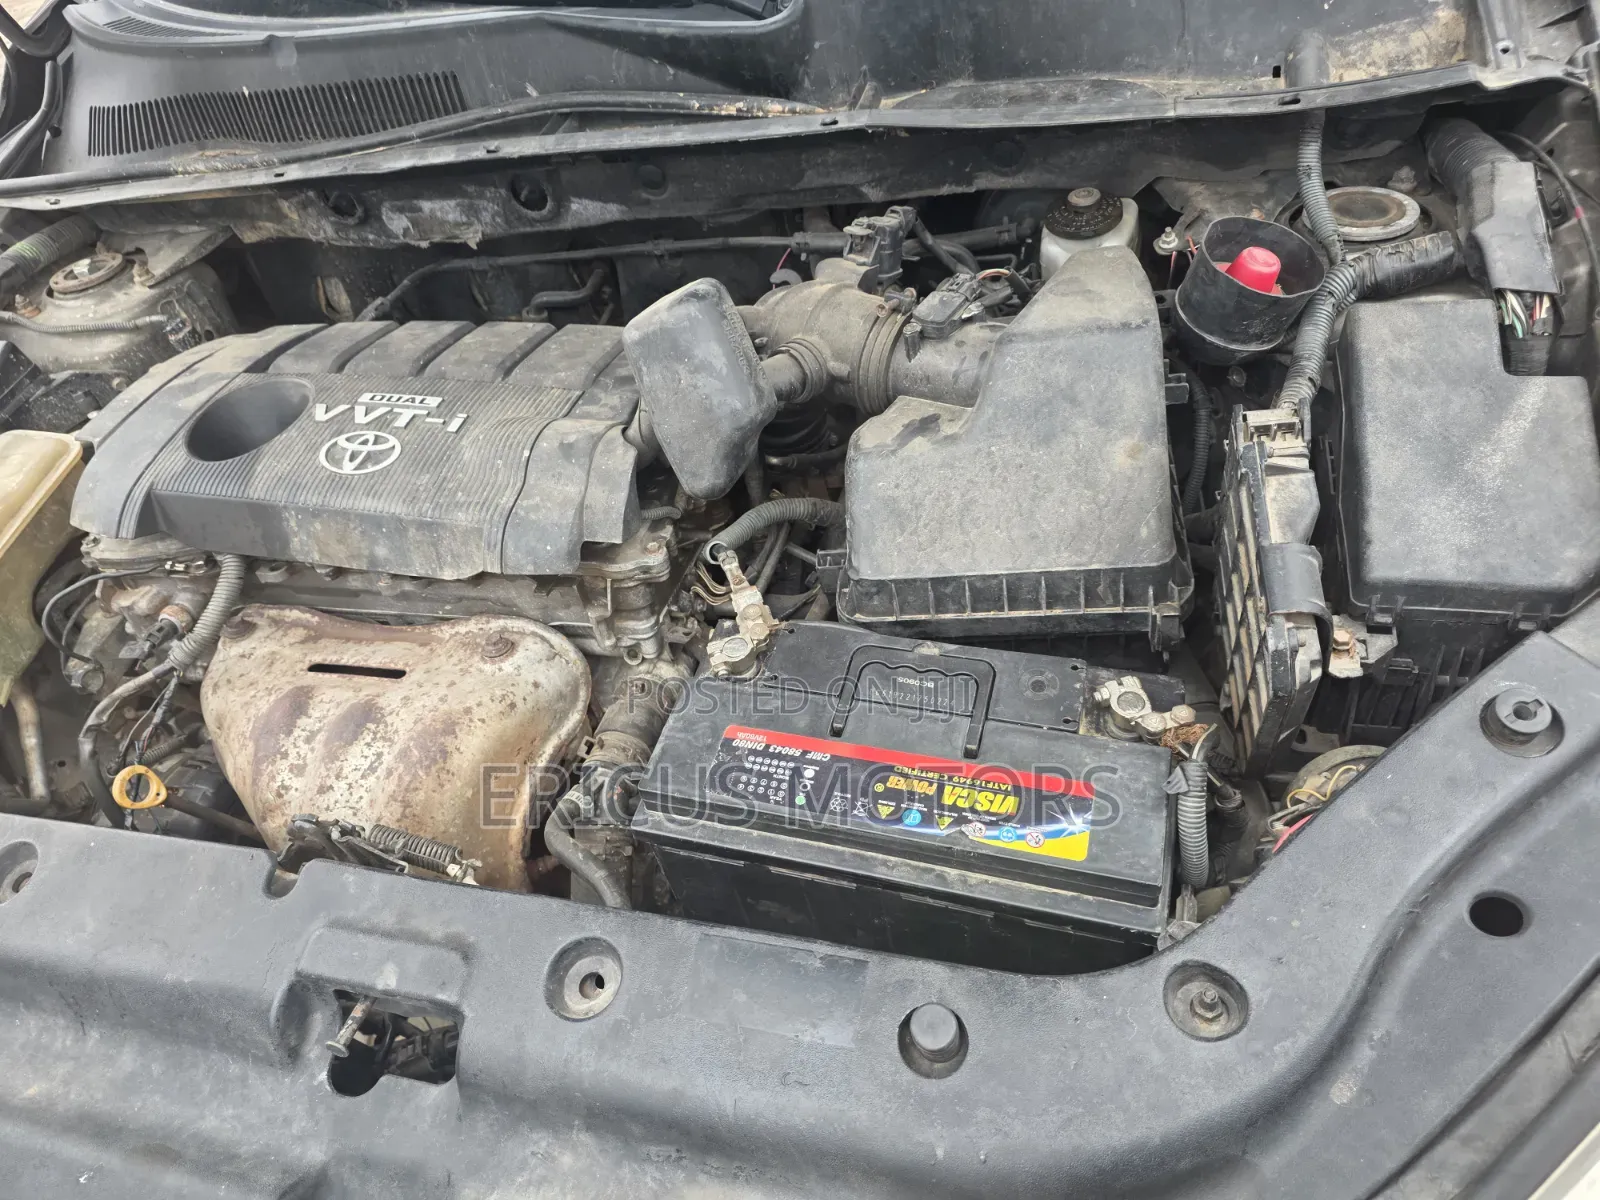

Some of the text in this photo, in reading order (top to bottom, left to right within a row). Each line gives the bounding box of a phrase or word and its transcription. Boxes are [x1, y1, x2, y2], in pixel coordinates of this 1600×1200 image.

[368, 394, 432, 406] DUAL
[315, 403, 469, 434] VVT-i
[732, 739, 831, 762] CMF 58043 DIN80
[886, 775, 938, 796] POWER
[894, 765, 1012, 792] IATF16949 CERTIFIED
[941, 785, 1019, 816] VISCA
